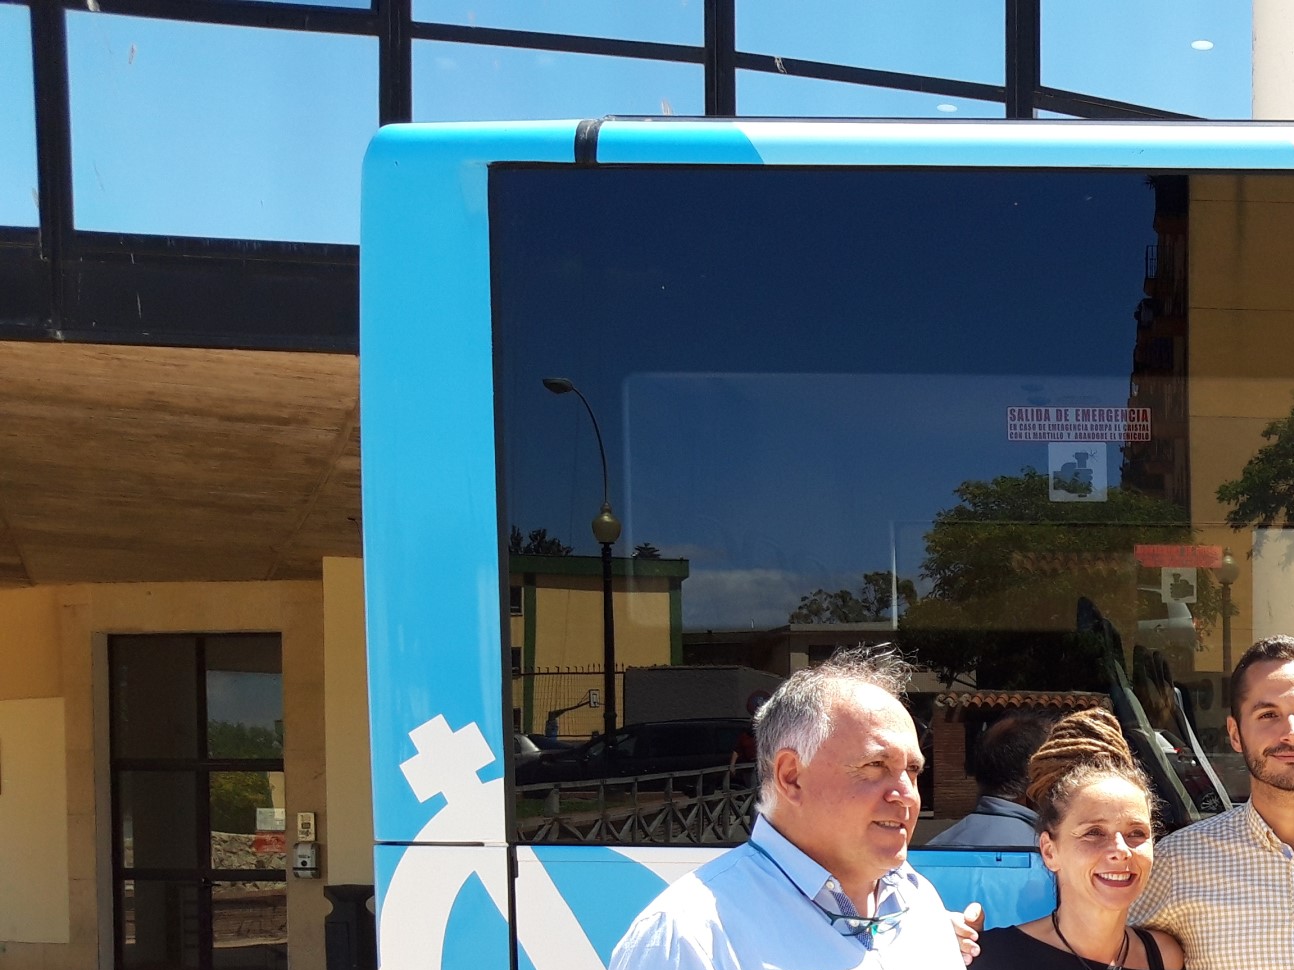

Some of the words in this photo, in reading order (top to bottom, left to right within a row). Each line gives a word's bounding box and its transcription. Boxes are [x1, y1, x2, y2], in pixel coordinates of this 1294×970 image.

[1009, 408, 1051, 423] SALIDA
[1055, 408, 1070, 423] DE
[1075, 408, 1149, 423] EMERGENCIA
[1019, 423, 1037, 432] CASO
[1038, 423, 1047, 432] DE
[1048, 423, 1089, 432] EMERGENCIA
[1090, 424, 1113, 432] ROMPA
[1114, 424, 1122, 432] EL
[1123, 424, 1149, 432] CRISTAL
[1009, 432, 1023, 440] CON
[1025, 432, 1032, 440] EL
[1033, 432, 1064, 440] MARTILLO
[1074, 432, 1109, 440] ABANDONE
[1110, 432, 1118, 440] EL
